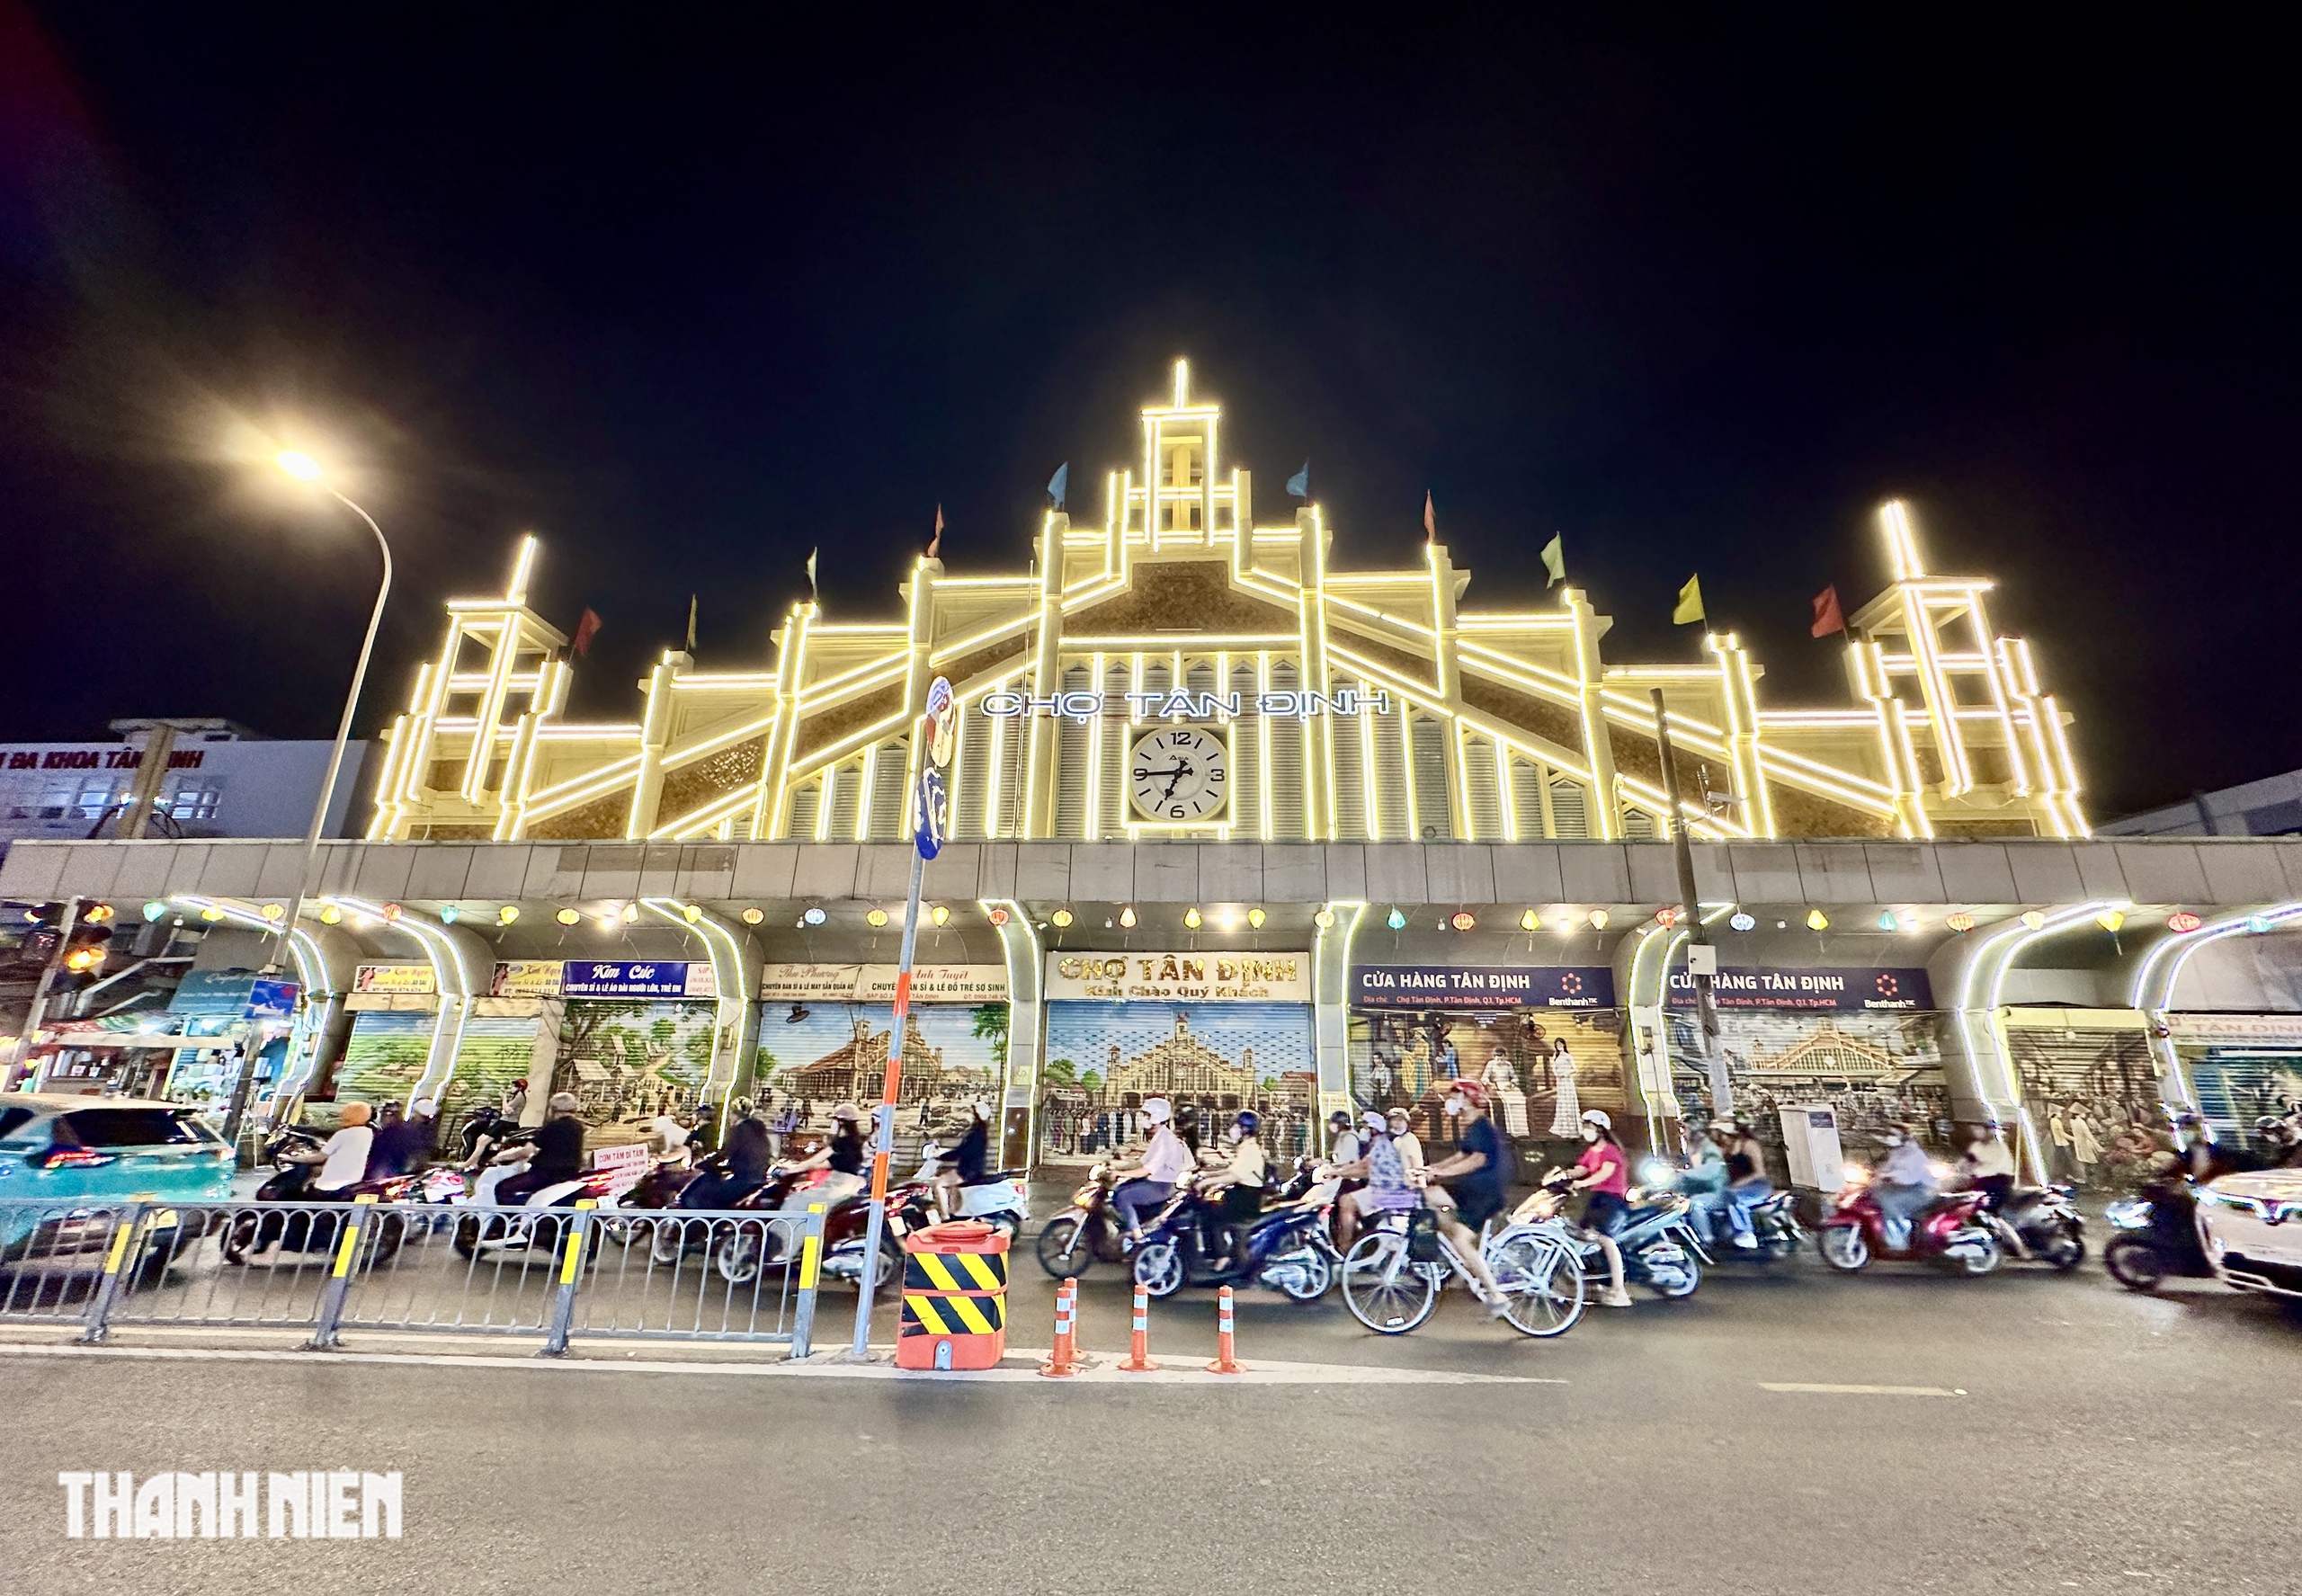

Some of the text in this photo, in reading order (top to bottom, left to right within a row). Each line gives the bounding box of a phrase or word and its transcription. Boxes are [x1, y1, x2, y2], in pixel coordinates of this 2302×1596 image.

[980, 688, 1390, 724] CHỢ TÂN ĐỊNH
[1171, 732, 1191, 745] 12
[41, 751, 101, 769] KHOA
[1133, 768, 1148, 781] 9
[1210, 769, 1225, 782] 3
[1170, 805, 1185, 818] 6
[592, 963, 656, 979] Kim Cúc
[779, 965, 840, 982] Thu Phương
[939, 968, 969, 981] Tuyết
[1058, 953, 1298, 987] CHỢ TÂN ĐỊNH
[872, 982, 896, 991] CHUYÊ
[1362, 970, 1530, 992] CỬA HÀNG TÂN ĐỊNH
[1709, 972, 1757, 989] HÀNG
[1761, 972, 1797, 990] TÂN
[1800, 976, 1844, 994] ĐỊNH
[1085, 985, 1270, 999] Kính Chào Quý Khách
[1363, 995, 1375, 1003] Địa
[1411, 995, 1423, 1003] Tân
[1495, 996, 1521, 1004] Tp.HCM
[1548, 997, 1588, 1006] Benthanh
[1721, 997, 1735, 1005] Tân
[1863, 999, 1905, 1008] Benthanh
